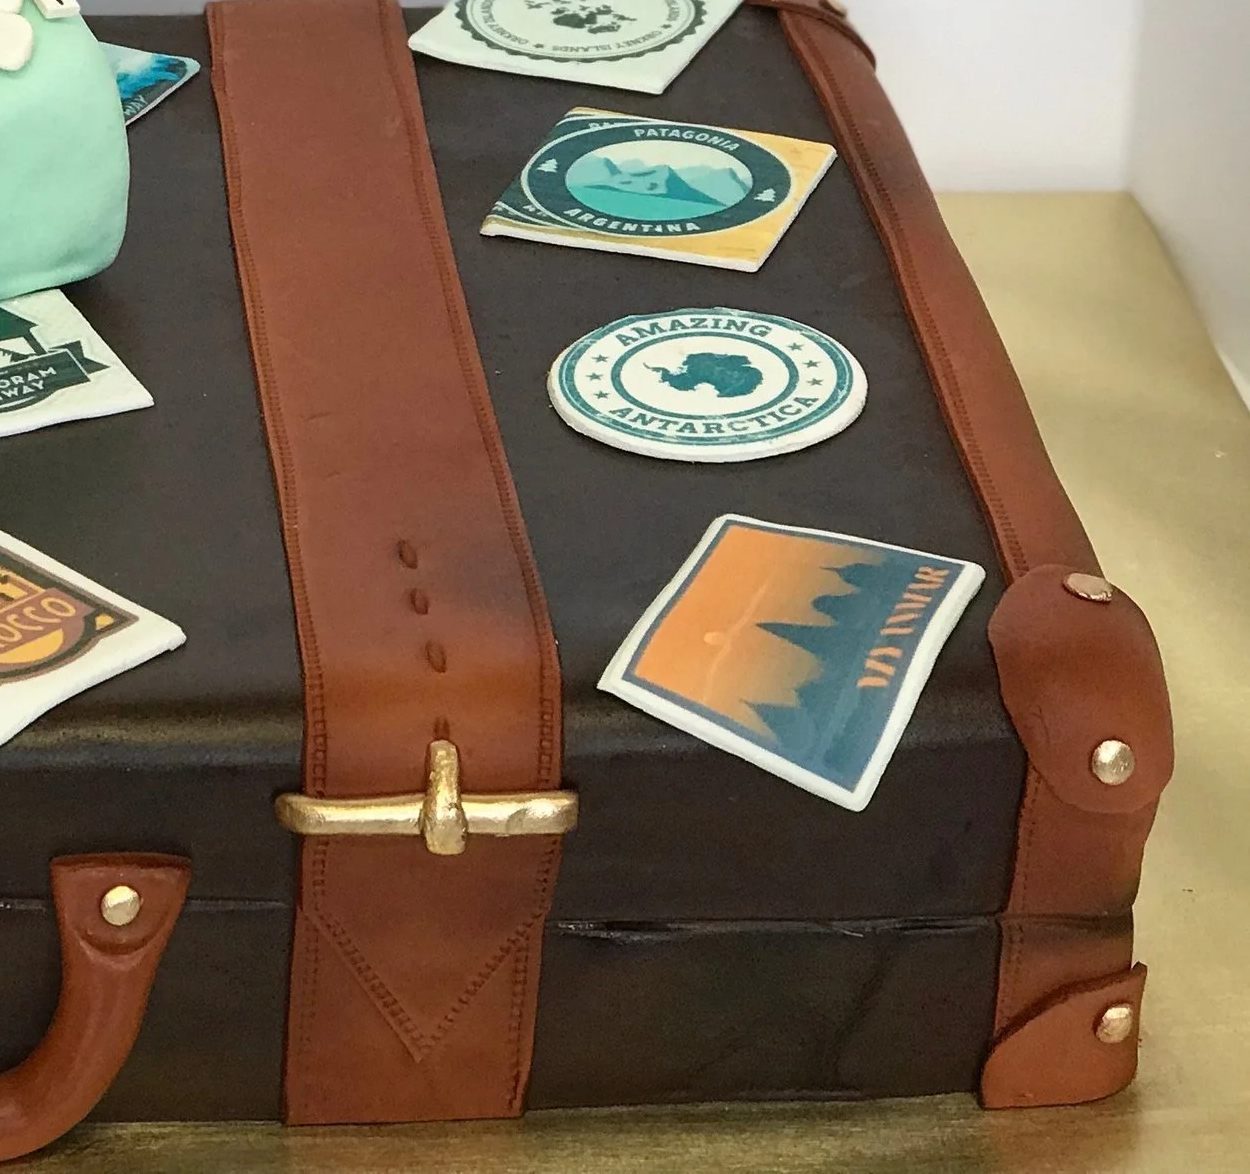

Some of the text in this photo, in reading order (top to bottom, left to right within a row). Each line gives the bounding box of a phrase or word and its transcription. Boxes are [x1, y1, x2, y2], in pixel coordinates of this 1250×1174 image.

[633, 126, 741, 153] PATAGONIA
[563, 207, 702, 234] ARGENTINA
[614, 317, 773, 348] AMAZING
[609, 395, 820, 434] ANTARCTICA
